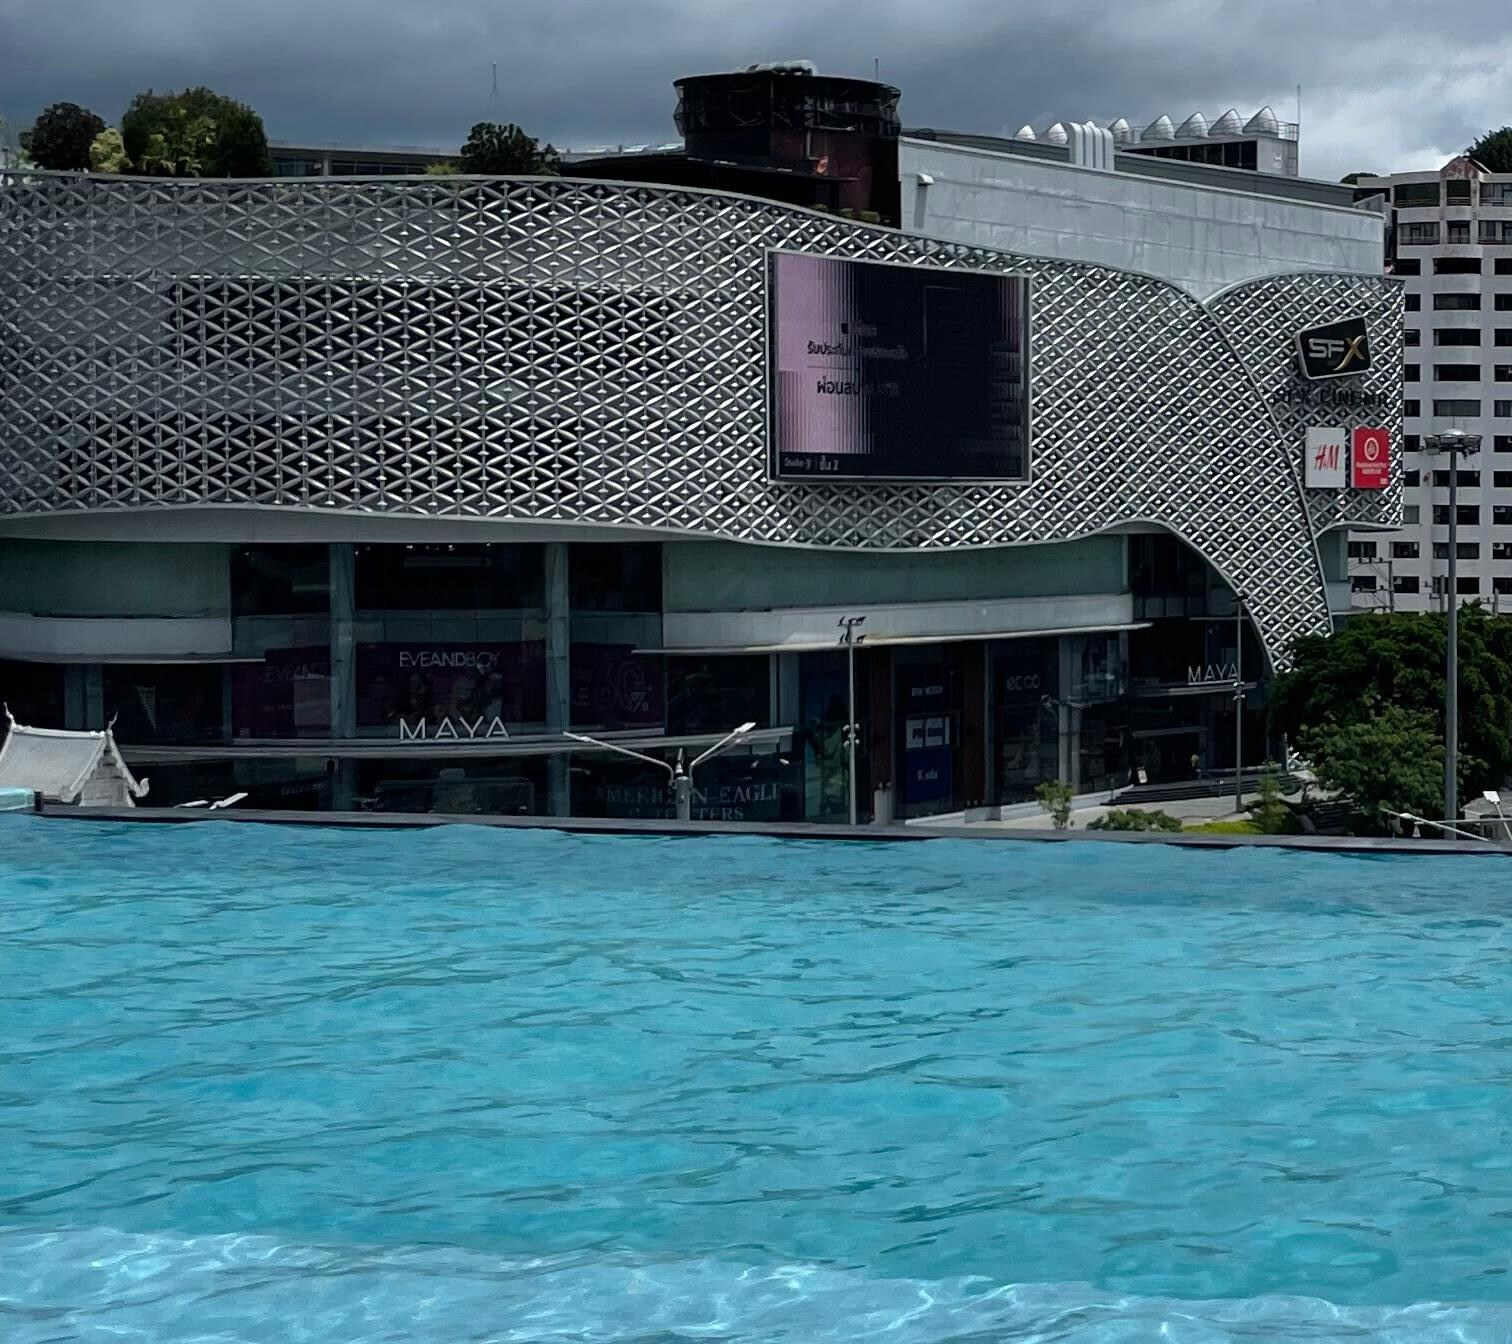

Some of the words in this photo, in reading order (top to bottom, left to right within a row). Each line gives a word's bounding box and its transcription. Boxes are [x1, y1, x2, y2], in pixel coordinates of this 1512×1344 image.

[1308, 335, 1367, 371] SFX
[1315, 444, 1340, 471] H&M
[1188, 664, 1240, 682] MAYA
[400, 716, 510, 739] MAYA
